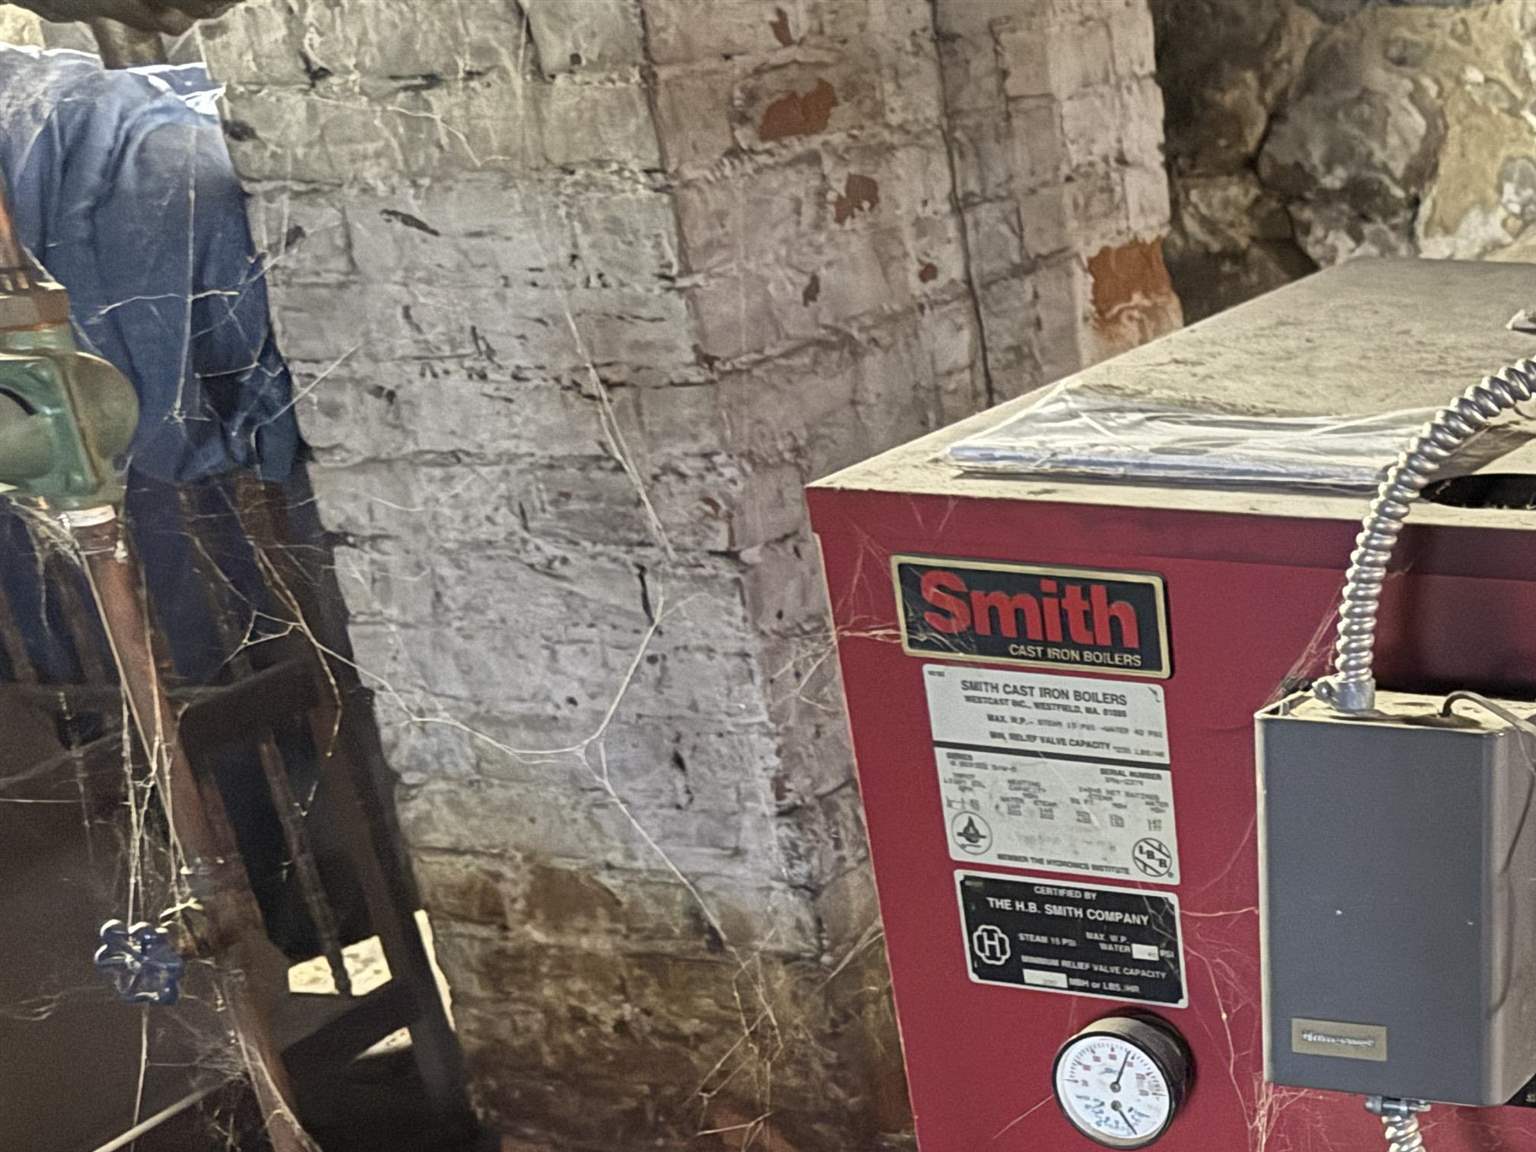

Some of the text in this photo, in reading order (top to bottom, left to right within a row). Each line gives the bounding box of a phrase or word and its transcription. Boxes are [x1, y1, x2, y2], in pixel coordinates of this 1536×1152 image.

[921, 569, 1139, 649] Smith
[1008, 643, 1142, 667] CAST IRON BOILERS
[961, 680, 1128, 706] SMITH CAST IRON BOILERS
[1034, 886, 1097, 900] CERTIFIED BY
[985, 897, 1150, 925] THE H.B. SMITH COMPANY
[1092, 964, 1121, 975] VALVE
[1122, 967, 1167, 979] CAPACITY
